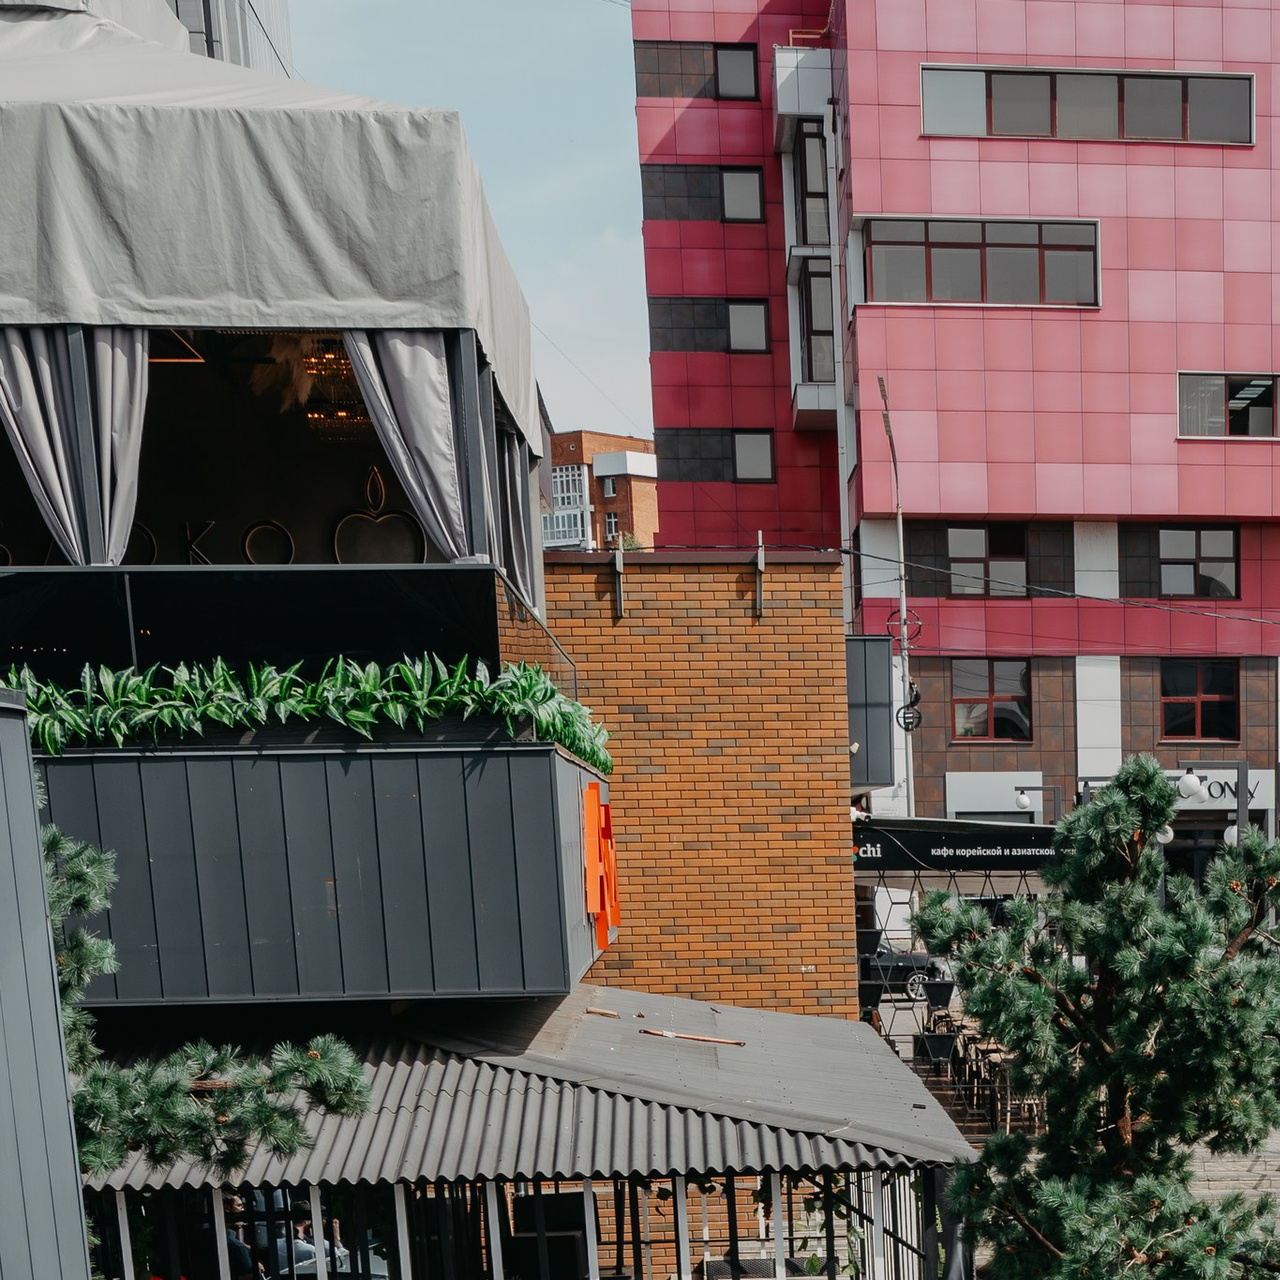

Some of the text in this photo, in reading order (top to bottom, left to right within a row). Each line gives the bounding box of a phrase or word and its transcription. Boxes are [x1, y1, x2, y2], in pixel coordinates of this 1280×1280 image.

[931, 846, 954, 858] кафе
[955, 846, 1002, 858] корейской
[1003, 848, 1010, 856] и
[1011, 846, 1055, 857] азиатской
